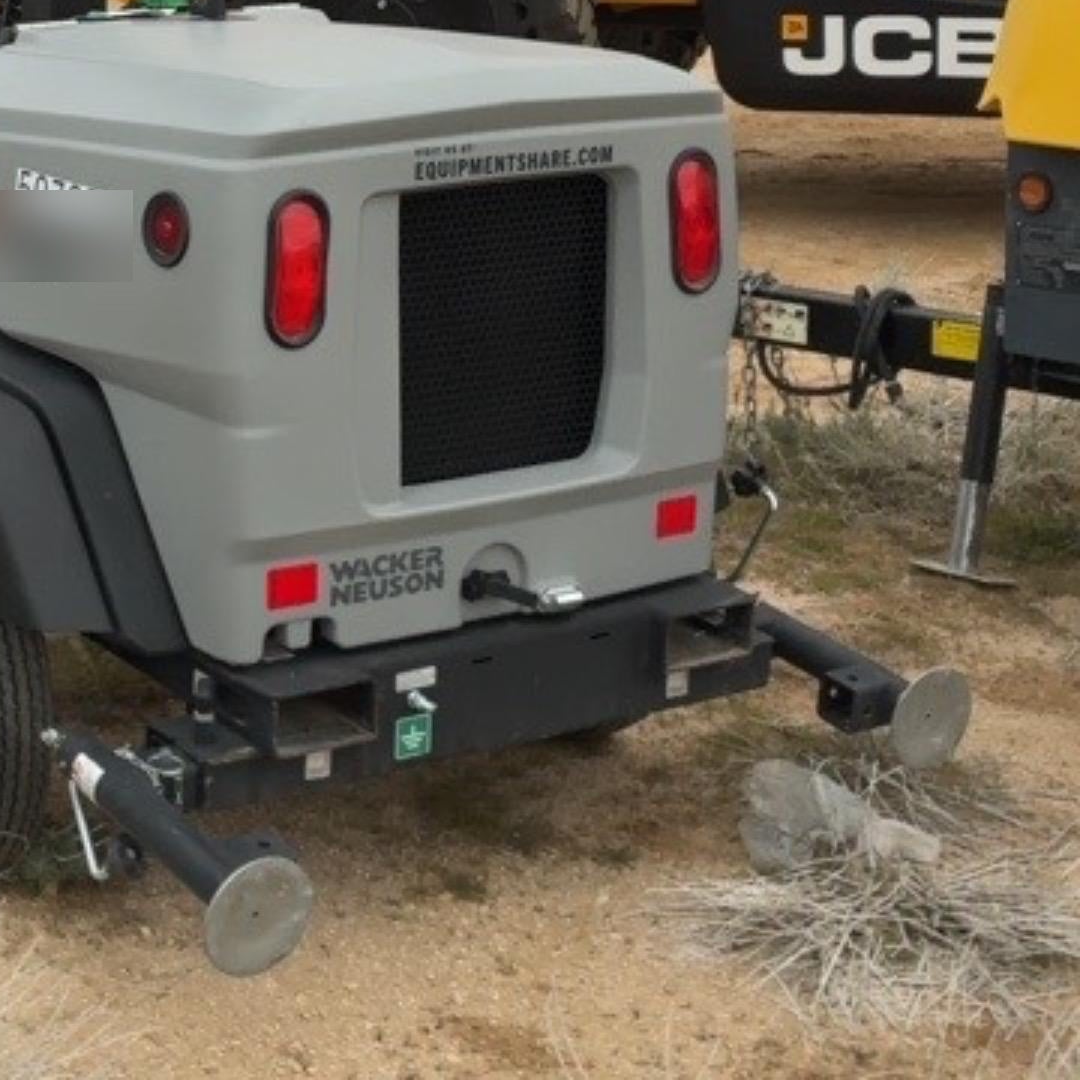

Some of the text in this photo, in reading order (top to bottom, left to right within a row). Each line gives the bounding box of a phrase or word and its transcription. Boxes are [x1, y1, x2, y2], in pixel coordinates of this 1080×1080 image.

[413, 144, 614, 181] EQUIPMENTSHARE.COM
[329, 546, 444, 583] WACKER
[329, 570, 445, 608] NEUSON
